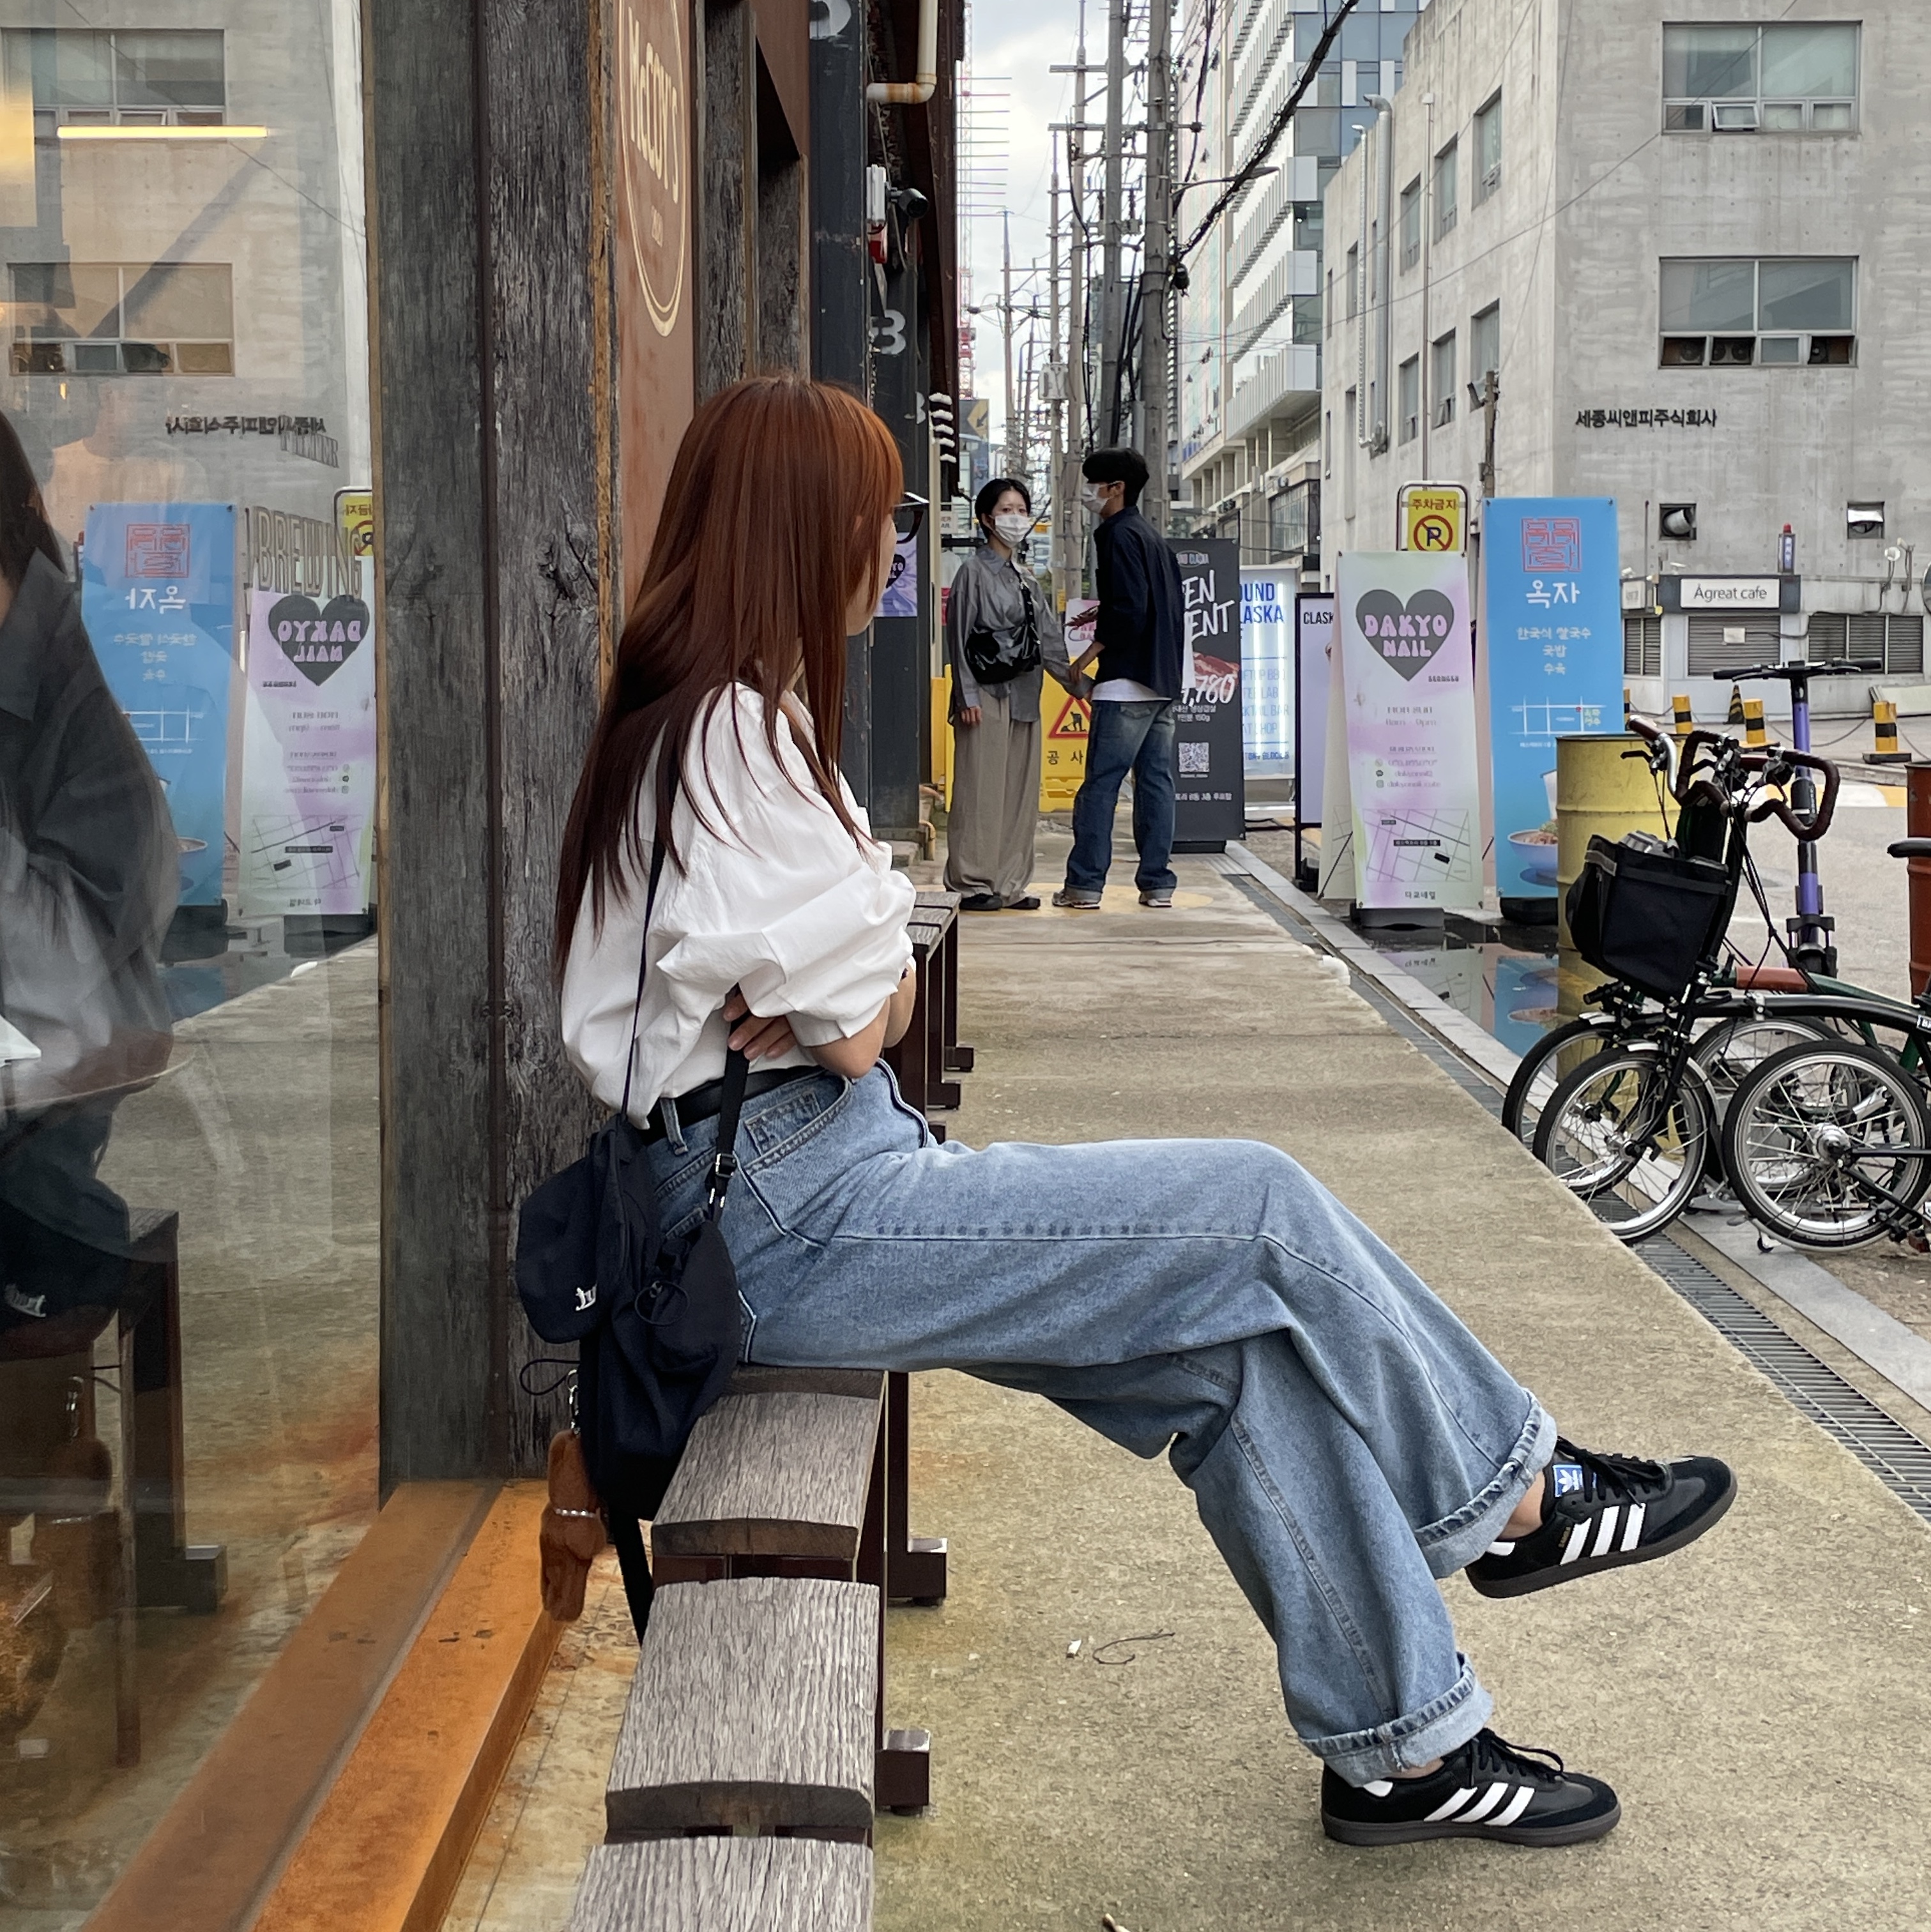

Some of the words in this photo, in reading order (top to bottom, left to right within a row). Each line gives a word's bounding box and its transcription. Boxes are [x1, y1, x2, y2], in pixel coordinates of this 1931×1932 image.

[1575, 409, 1717, 428] 세종씨앤피주식회사
[1412, 499, 1456, 510] 주차금지
[254, 506, 362, 602] BREWING
[1182, 570, 1214, 609] EN
[1525, 579, 1580, 609] 옥자
[1740, 586, 1767, 600] cafe
[1189, 600, 1235, 641] ENT
[1240, 605, 1285, 624] ASKA
[1364, 614, 1447, 637] DAKYO
[1516, 627, 1552, 640] 한국식
[1556, 627, 1591, 640] 쌀국수
[1383, 639, 1432, 657] NAIL
[1543, 644, 1567, 658] 국밥
[1544, 662, 1566, 676] 수육
